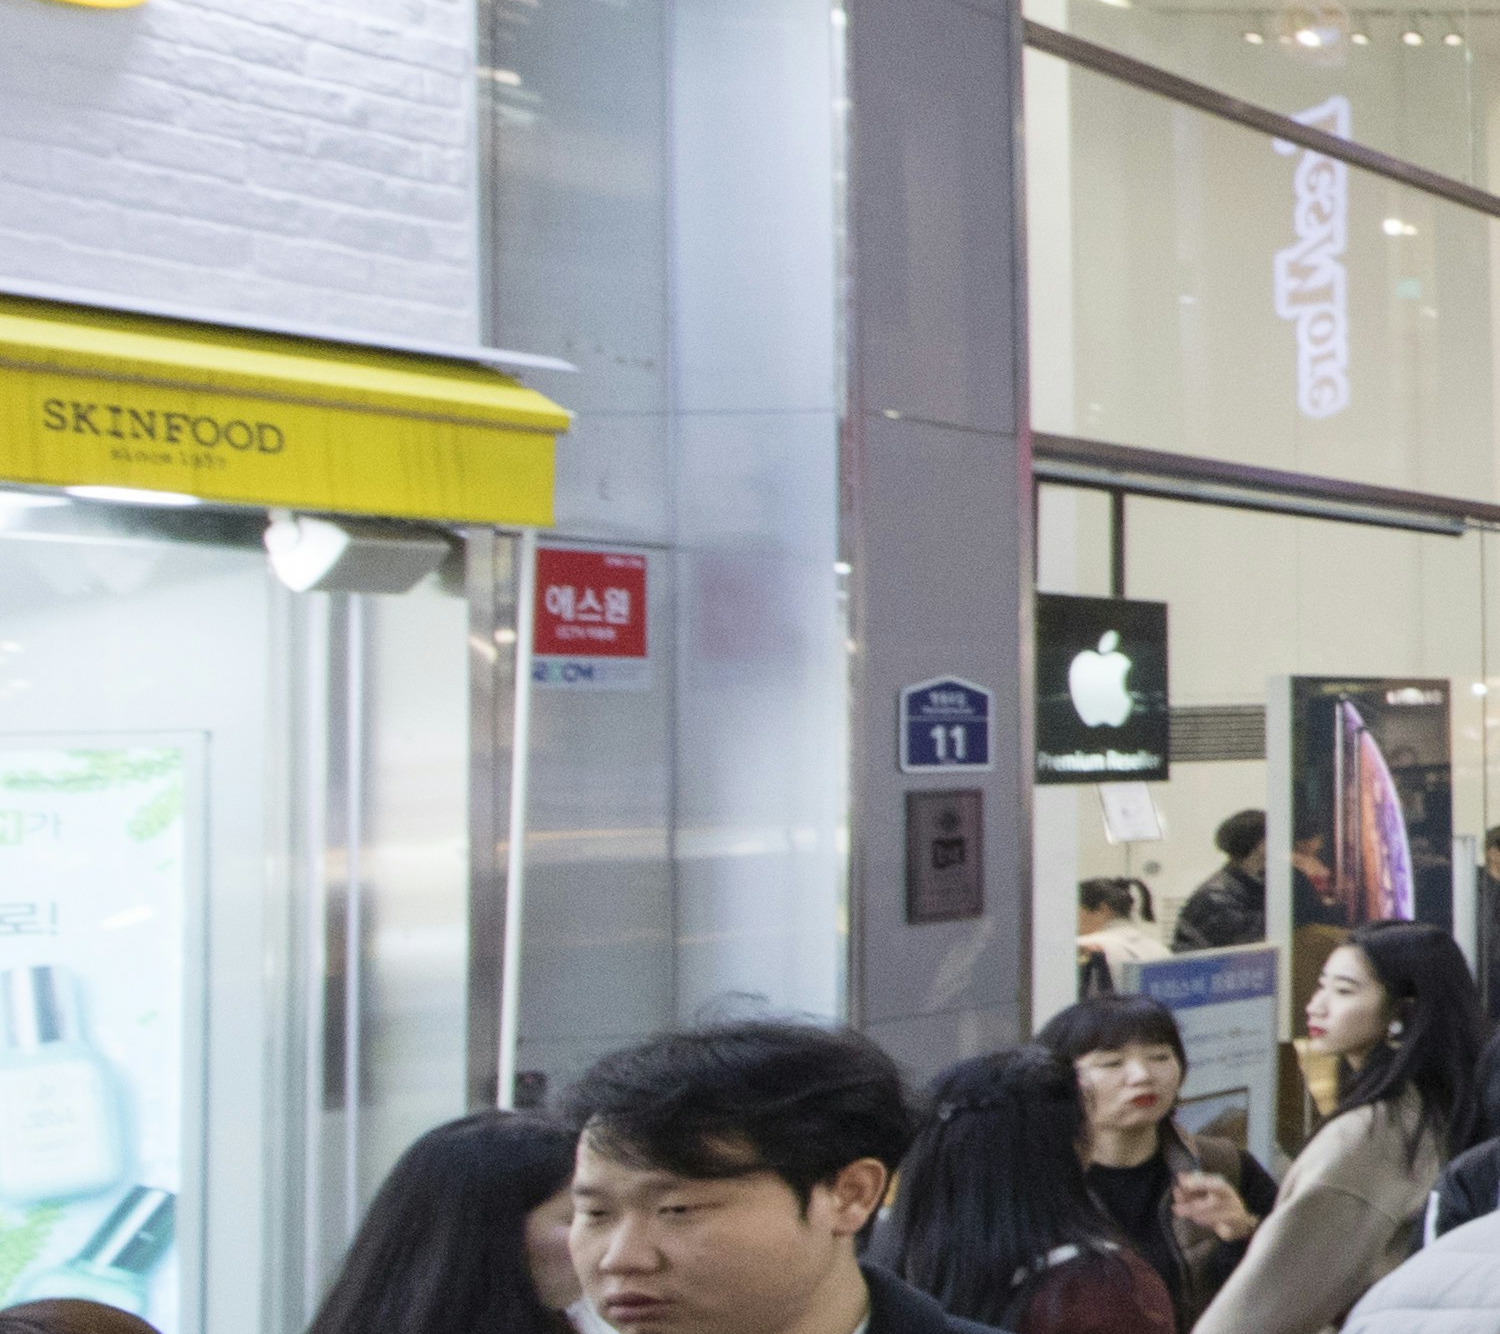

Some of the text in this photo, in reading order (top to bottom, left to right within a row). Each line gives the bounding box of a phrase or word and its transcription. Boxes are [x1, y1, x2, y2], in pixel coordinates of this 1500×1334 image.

[43, 397, 286, 456] SKINFOOD
[544, 585, 631, 626] 에스원
[930, 724, 968, 762] 11
